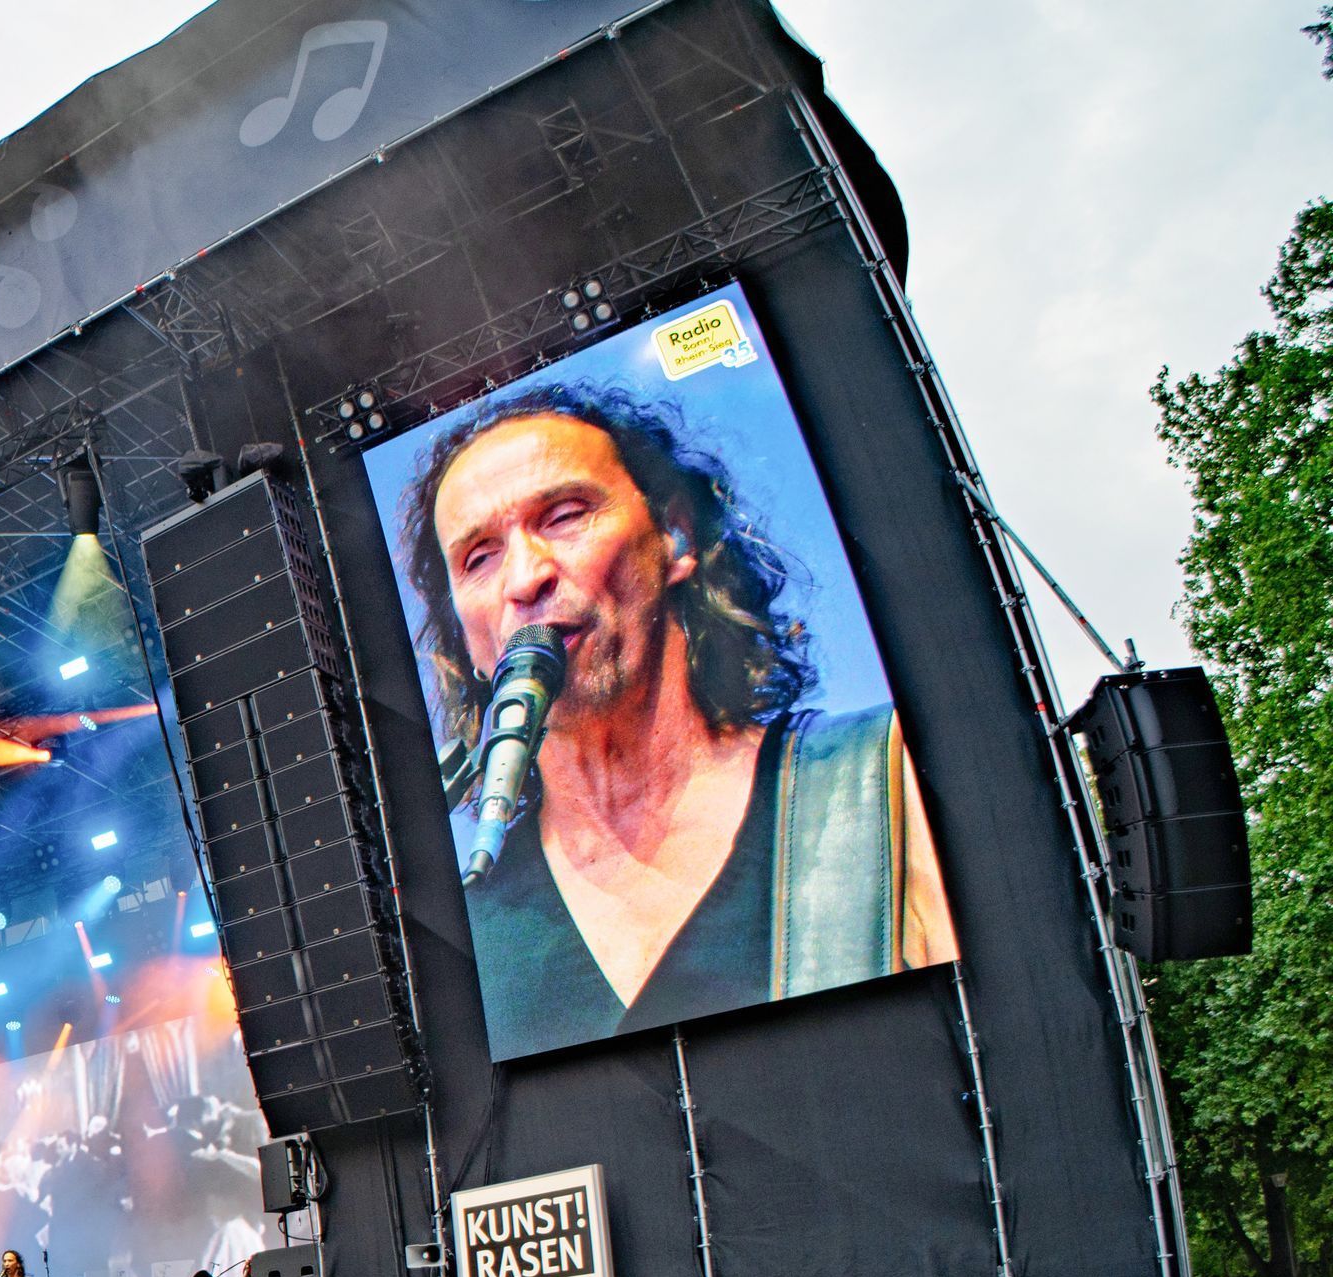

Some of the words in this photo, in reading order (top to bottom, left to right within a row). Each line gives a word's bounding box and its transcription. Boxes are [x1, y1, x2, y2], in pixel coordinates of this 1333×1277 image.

[668, 317, 722, 347] Radio
[674, 337, 733, 367] Rhein-Sieg
[724, 340, 751, 365] 35
[466, 1191, 587, 1247] KUNST!
